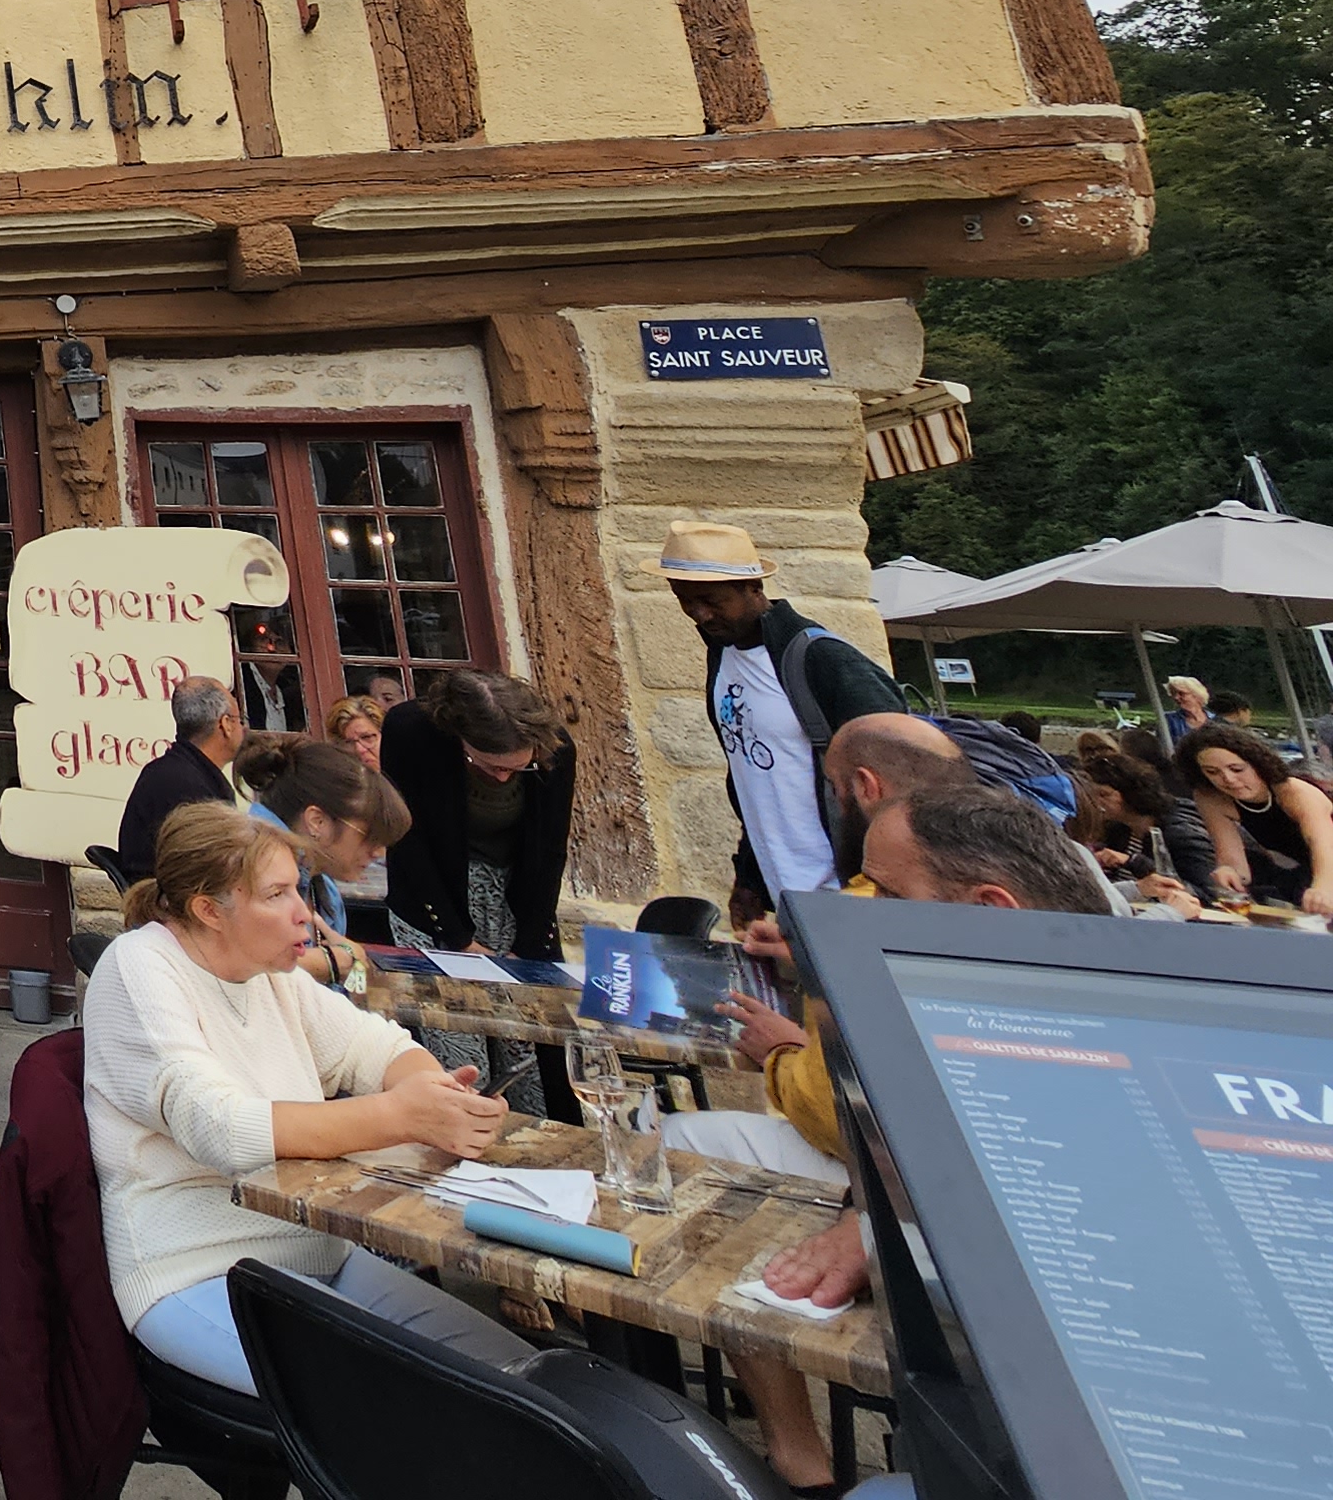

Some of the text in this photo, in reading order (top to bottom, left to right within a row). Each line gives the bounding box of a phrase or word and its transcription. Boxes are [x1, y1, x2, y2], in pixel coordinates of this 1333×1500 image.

[697, 326, 764, 341] PLACE
[649, 349, 826, 368] SAINT SAUVEUR
[25, 580, 206, 631] crêperie
[609, 951, 633, 1015] FRANKLIN
[972, 1041, 1033, 1056] GALETTES
[1032, 1047, 1049, 1058] DE
